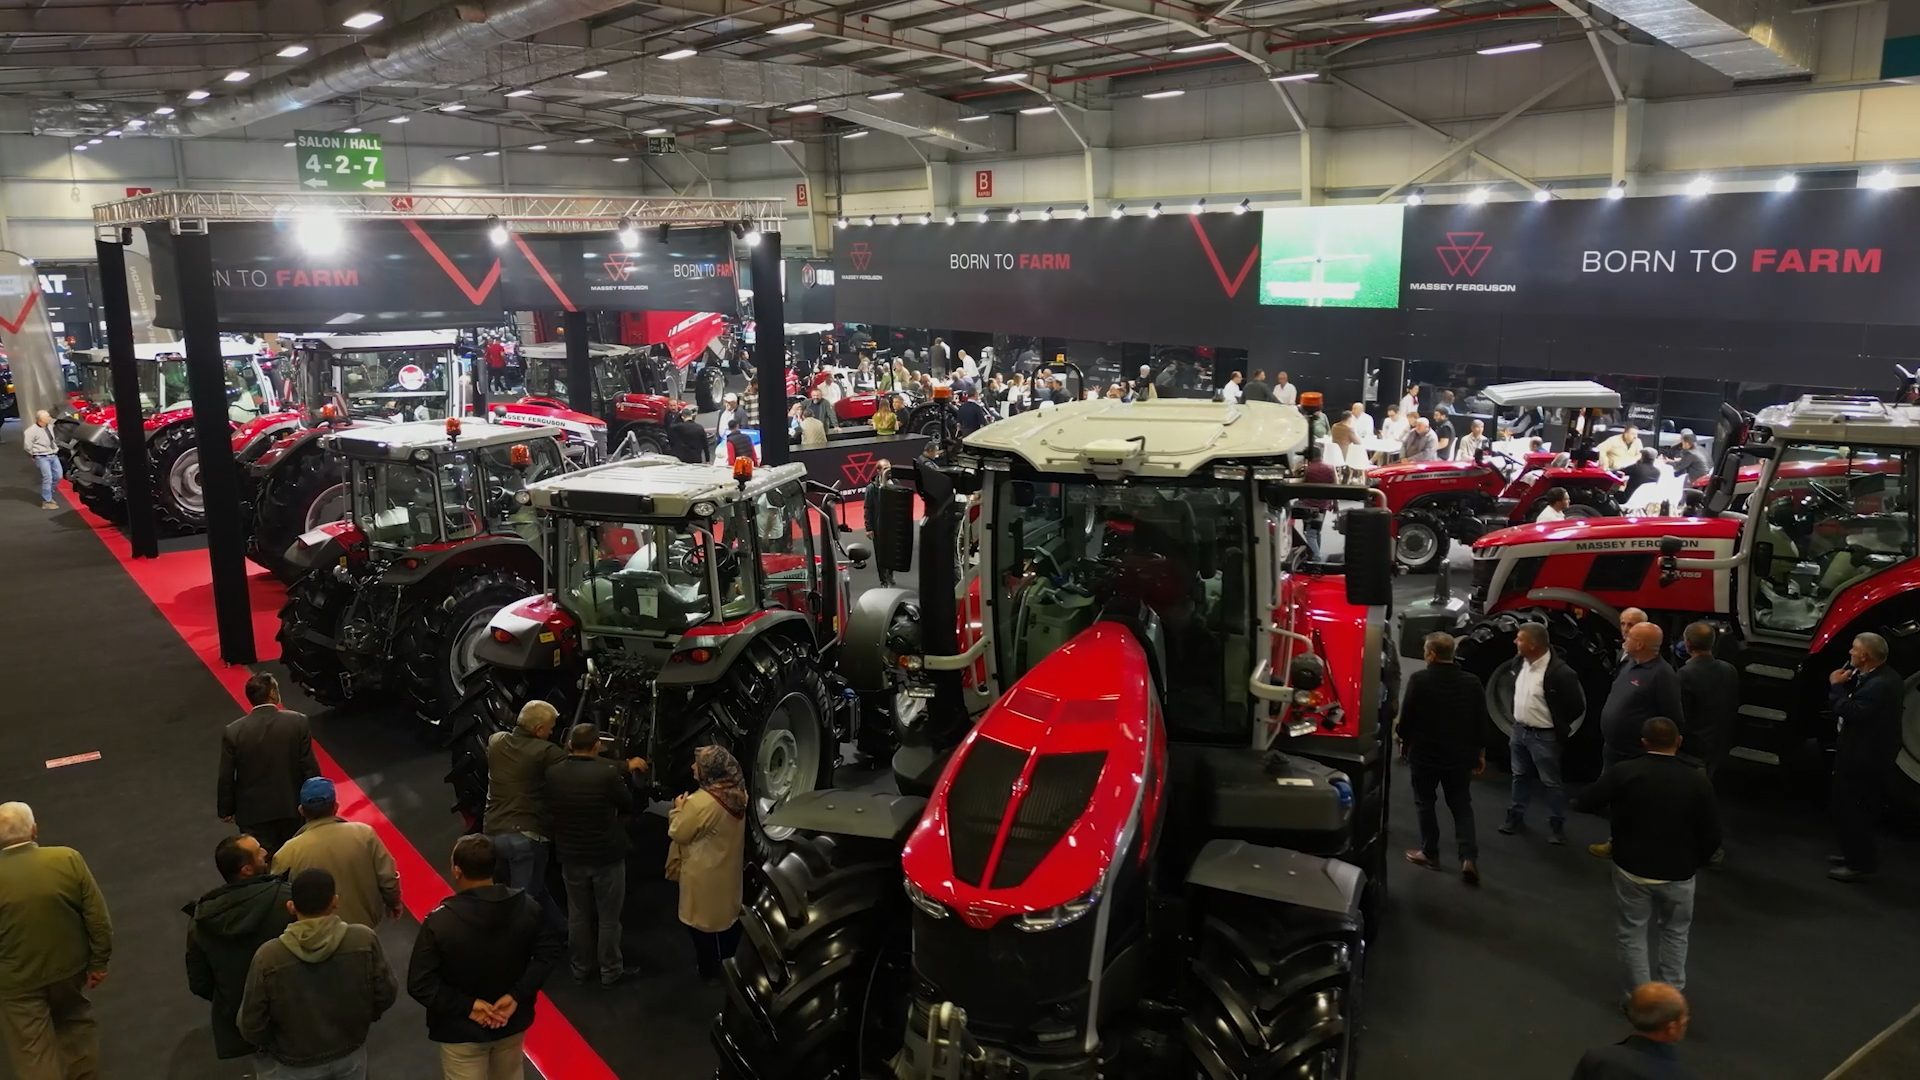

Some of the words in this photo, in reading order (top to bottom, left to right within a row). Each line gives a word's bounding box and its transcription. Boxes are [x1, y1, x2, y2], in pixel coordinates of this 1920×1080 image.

[298, 136, 340, 149] SALON
[350, 138, 382, 150] HALL
[980, 172, 988, 190] B
[799, 185, 806, 200] B
[950, 254, 990, 269] BORN
[994, 254, 1014, 270] TO
[1019, 254, 1071, 270] FARM
[1582, 249, 1676, 273] BORN
[1690, 249, 1737, 273] TO
[1752, 248, 1882, 273] FARM
[673, 264, 702, 278] BORN
[705, 263, 716, 278] TO
[236, 269, 268, 288] TO
[275, 269, 359, 288] FARM
[1410, 283, 1454, 291] MASSEY
[1456, 284, 1516, 292] FERGUSON
[528, 417, 566, 427] FERGUSON
[1576, 540, 1626, 550] MASSEY
